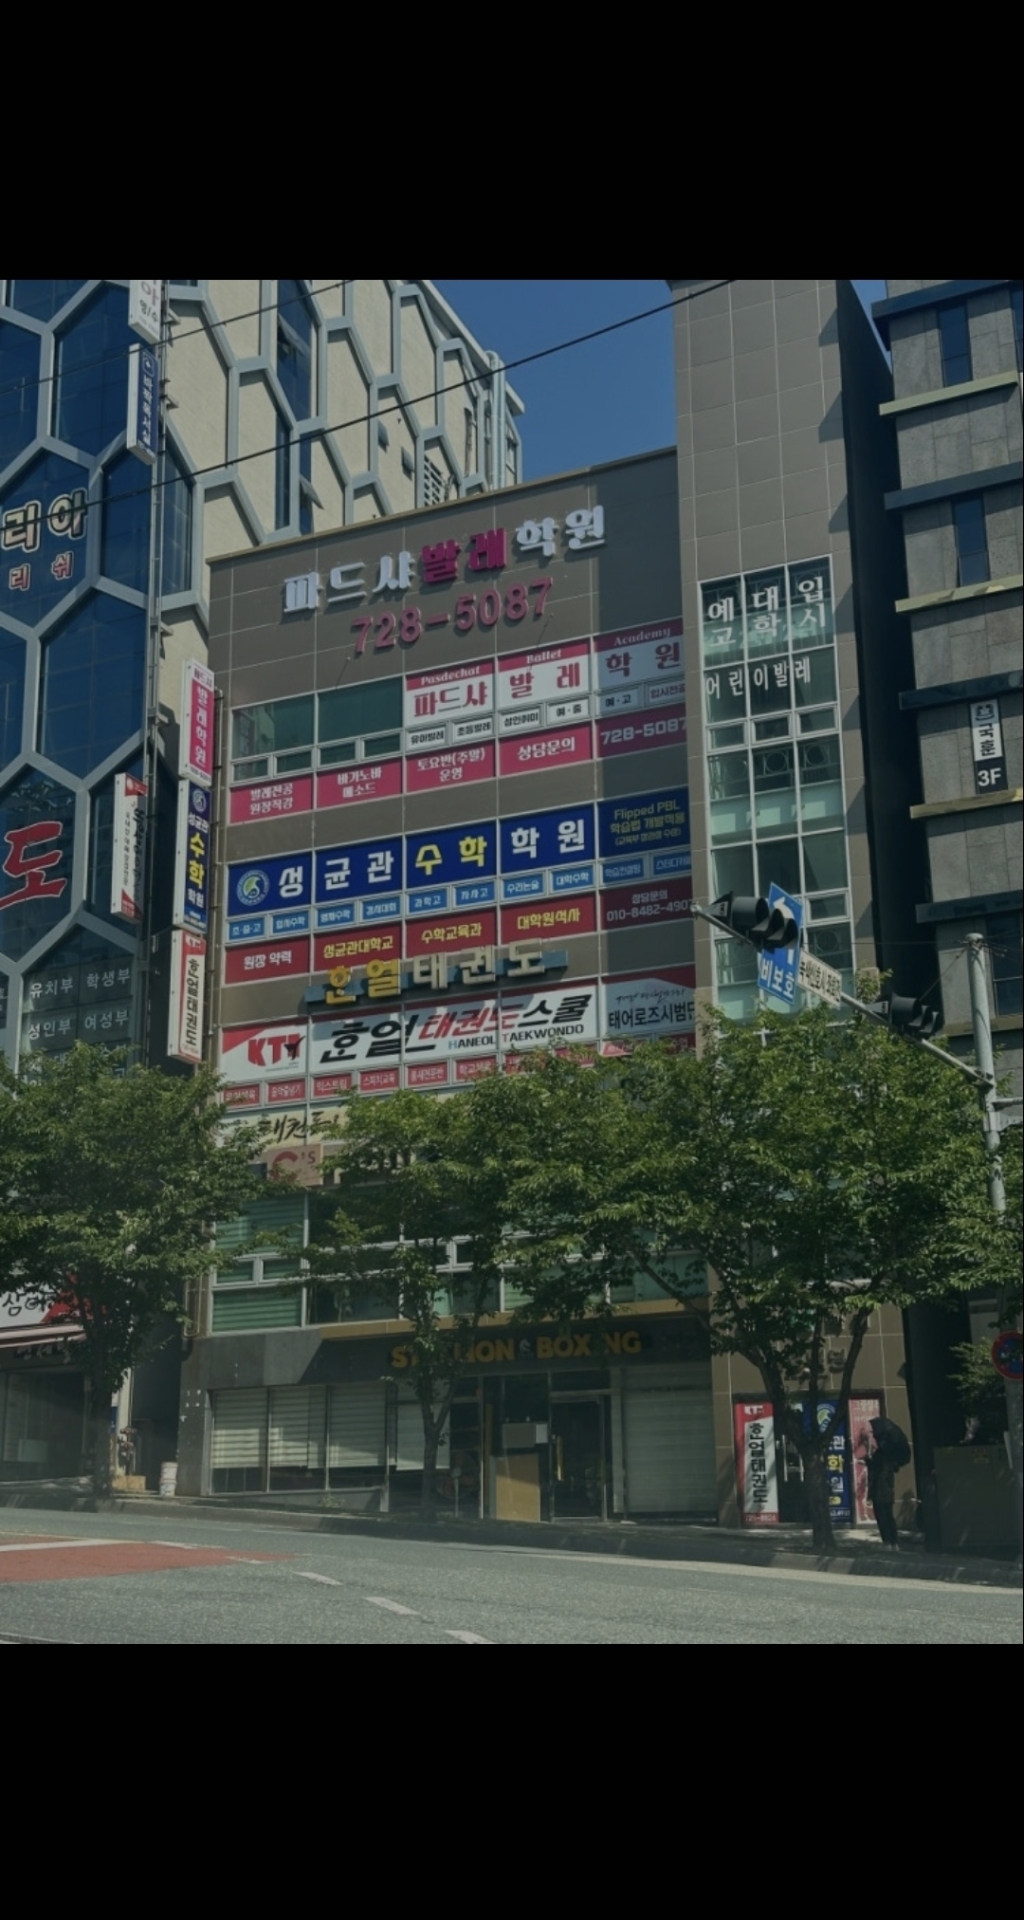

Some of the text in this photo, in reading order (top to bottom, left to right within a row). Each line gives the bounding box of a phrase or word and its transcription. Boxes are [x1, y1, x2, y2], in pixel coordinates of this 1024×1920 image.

[352, 577, 552, 654] 728-5087
[526, 648, 562, 664] Ballet
[613, 628, 671, 647] Academy
[414, 681, 488, 717] 파드샤
[417, 747, 486, 772] 토요반(주말)
[517, 737, 576, 761] 상담문의
[337, 767, 382, 786] 바가노바
[439, 767, 463, 783] 운영
[977, 767, 1002, 787] 3F
[250, 783, 293, 802] 발레전공
[342, 783, 376, 799] 메소드
[614, 799, 681, 821] Flipped PBL
[190, 832, 206, 889] 수학
[517, 908, 581, 931] 대학원석사
[421, 922, 482, 944] 수학교육과
[323, 935, 394, 959] 성균관대학교
[243, 949, 292, 970] 원장 약력
[30, 977, 74, 999] 유치부
[86, 968, 131, 989] 학생부
[760, 957, 798, 998] 비보호
[27, 1009, 129, 1040] 성인부 여성부
[448, 1024, 584, 1050] HANEOL TAEKWONDO
[316, 1077, 348, 1091] 익스트림
[363, 1071, 396, 1087] 스피치교육
[536, 1330, 642, 1360] BOXNG
